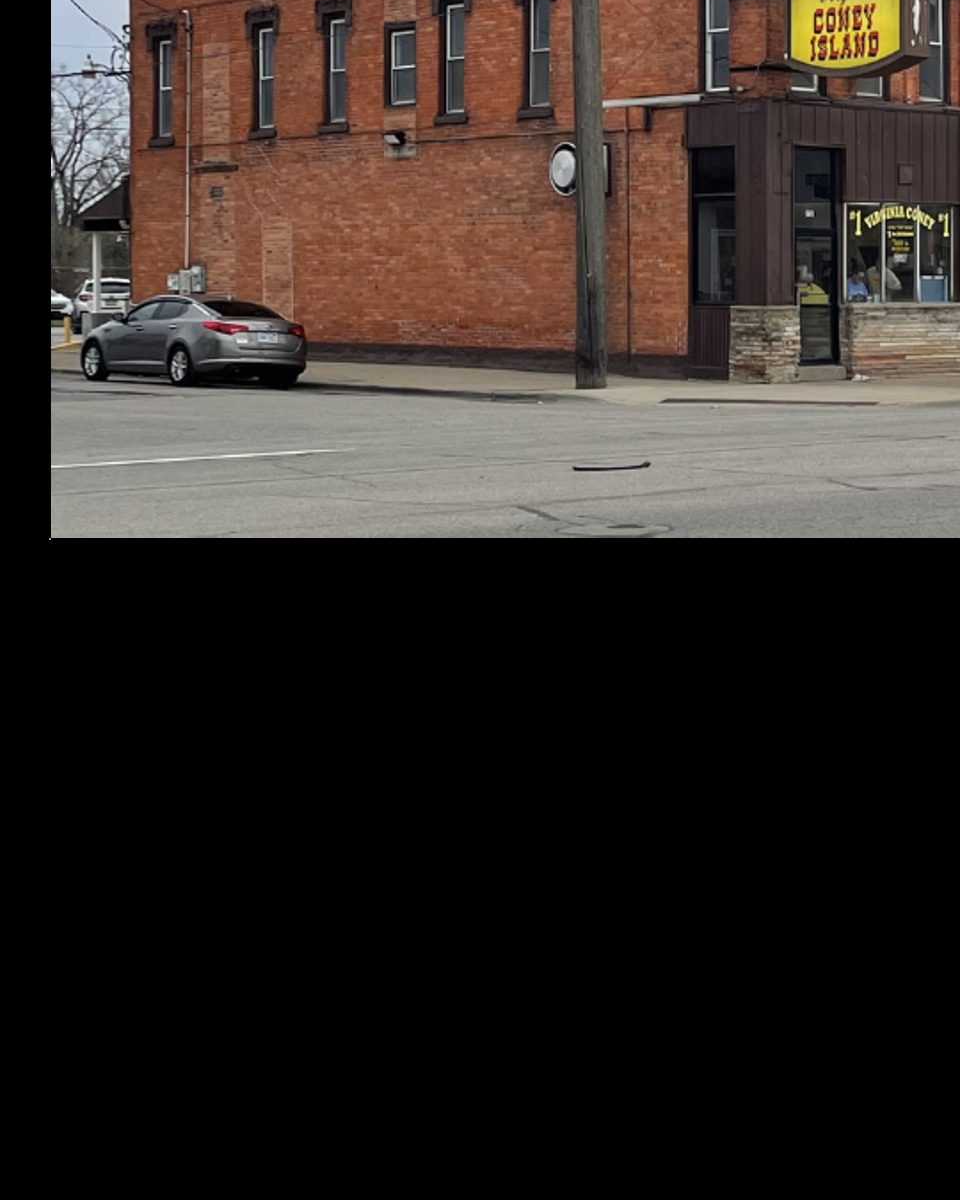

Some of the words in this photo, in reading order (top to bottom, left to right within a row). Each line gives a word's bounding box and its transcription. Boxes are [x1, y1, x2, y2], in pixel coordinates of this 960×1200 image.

[813, 3, 876, 34] CONEY
[810, 31, 879, 61] ISLAND
[906, 206, 936, 230] CONEY
